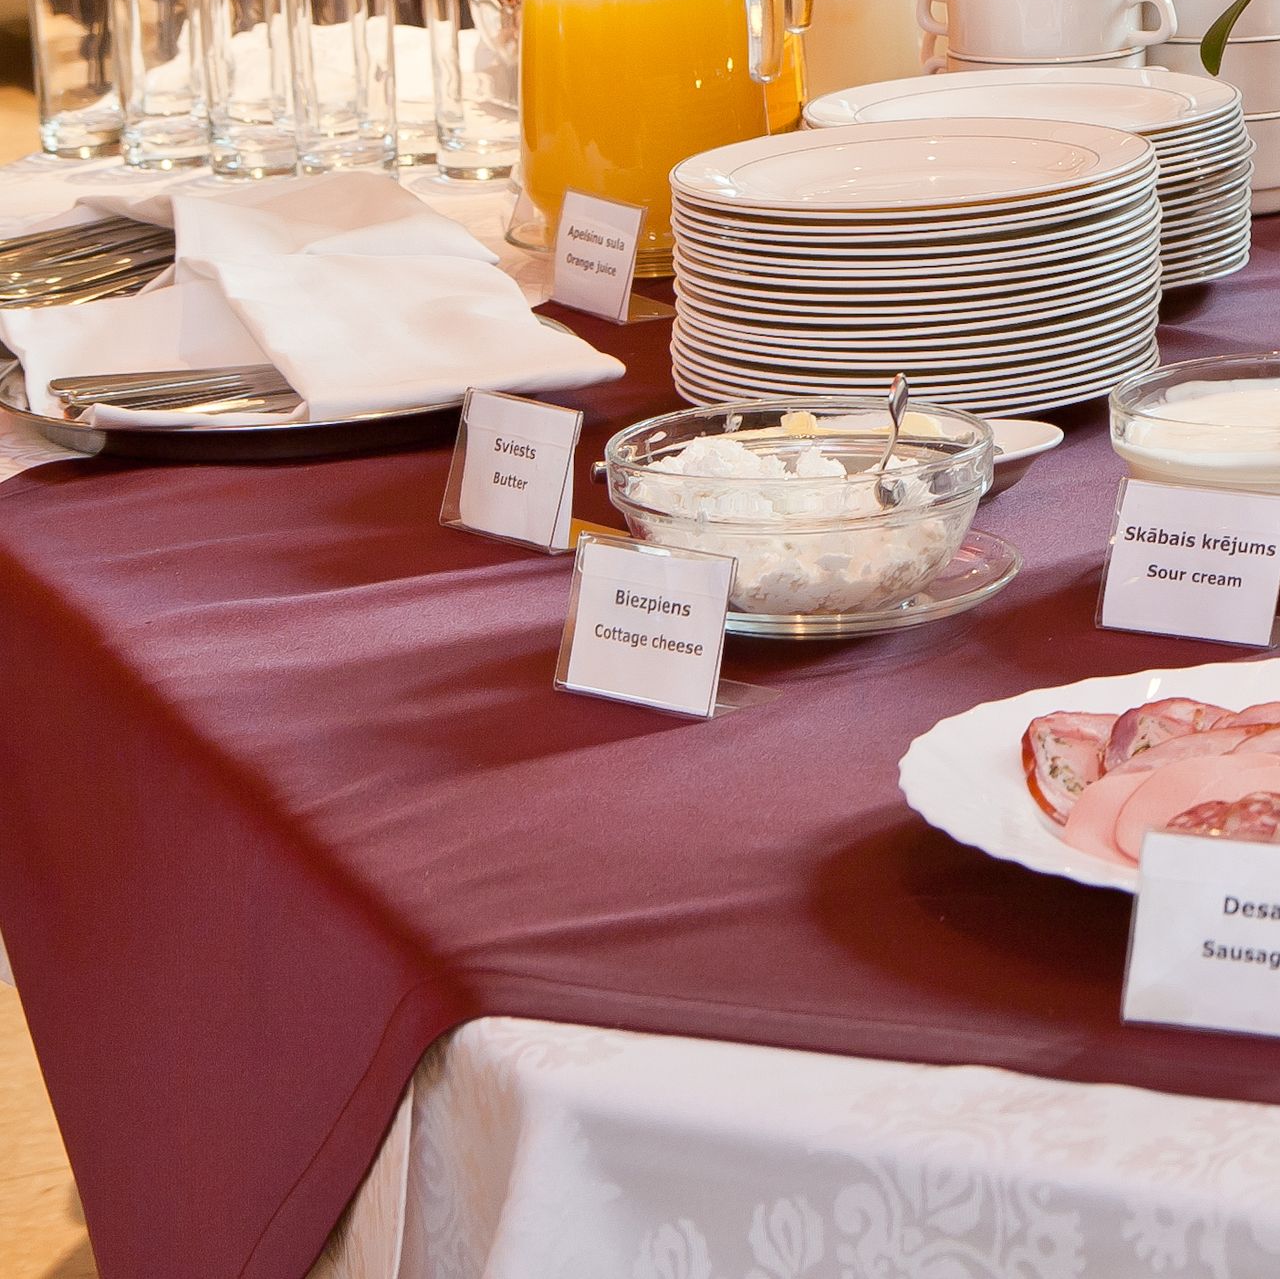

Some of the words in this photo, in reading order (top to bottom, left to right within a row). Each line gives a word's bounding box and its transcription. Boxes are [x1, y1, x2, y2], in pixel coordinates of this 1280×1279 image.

[606, 237, 625, 251] sula
[566, 253, 594, 271] Orange
[596, 261, 617, 277] juice
[494, 437, 536, 460] Sviests
[493, 472, 528, 491] Butter
[1124, 526, 1196, 548] Skābais
[1202, 534, 1277, 557] krējums
[1146, 564, 1187, 581] Sour
[1191, 570, 1242, 588] cream
[614, 589, 692, 617] Biezpiens
[594, 623, 648, 648] Cottage
[651, 634, 704, 656] cheese
